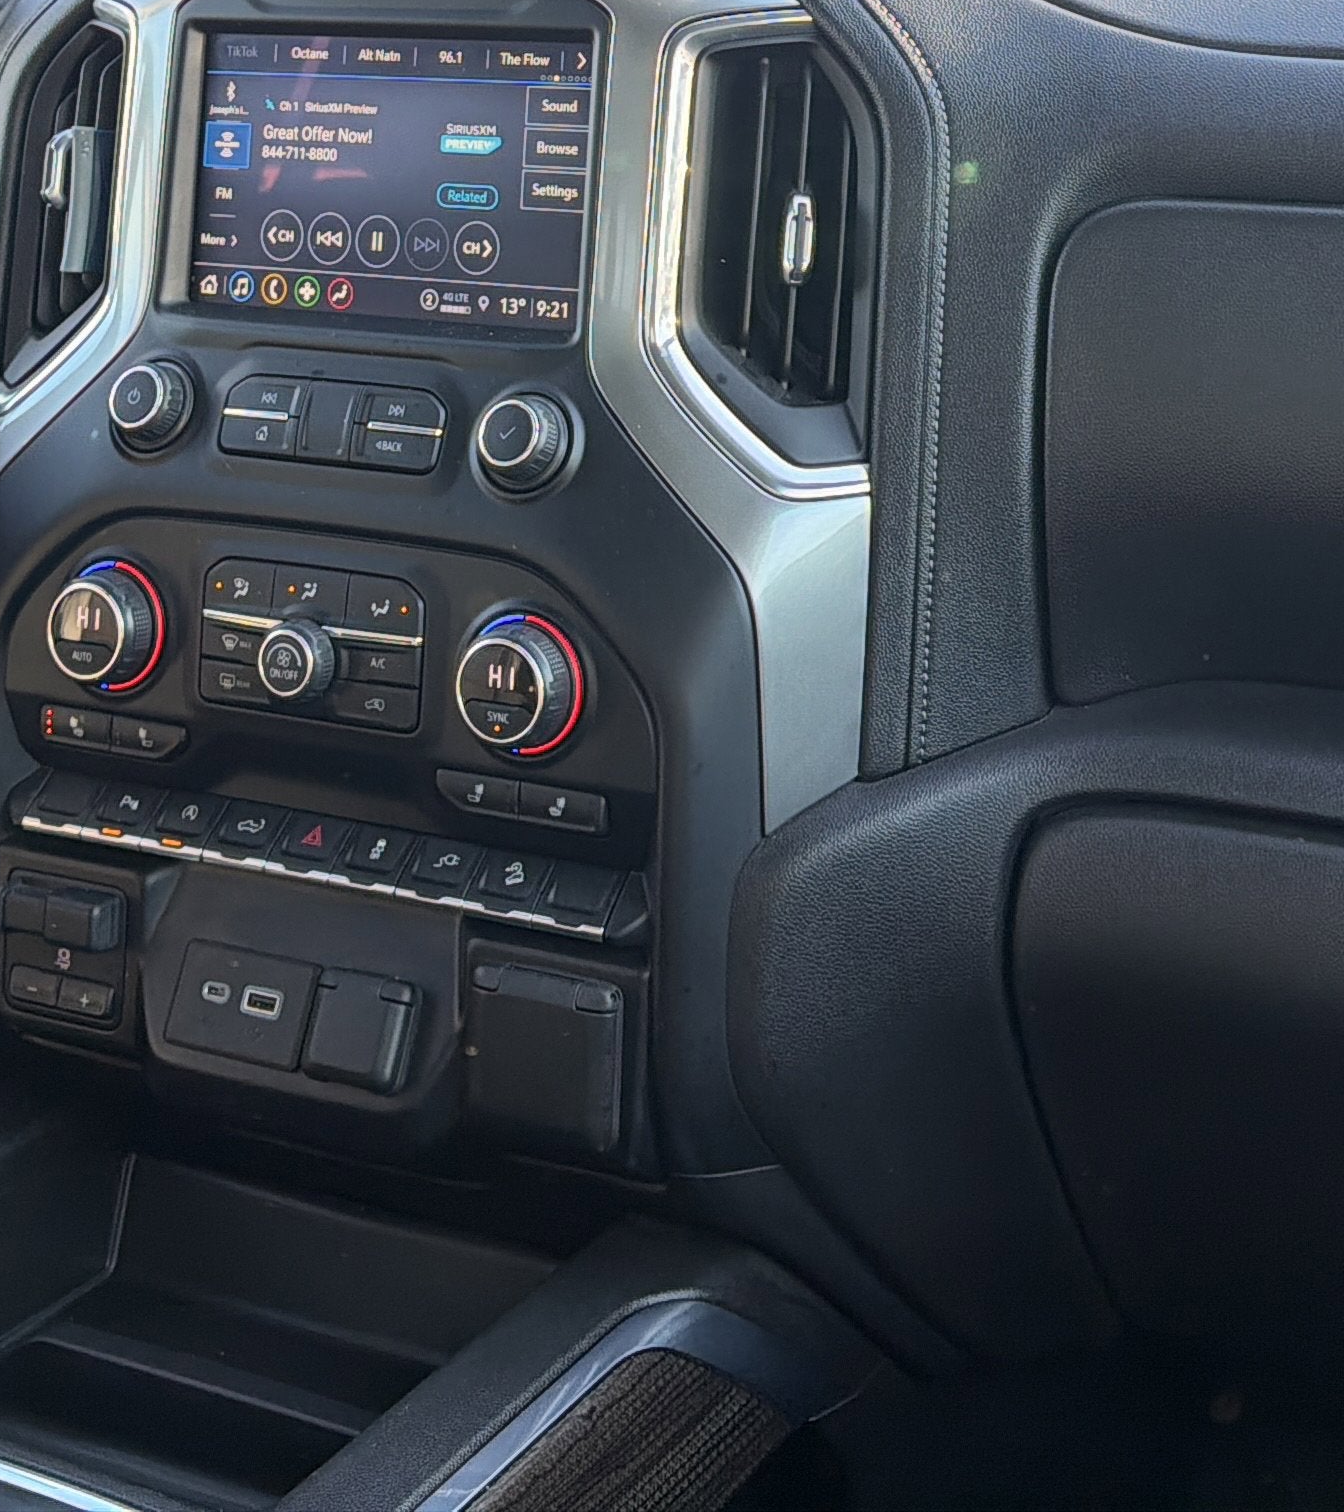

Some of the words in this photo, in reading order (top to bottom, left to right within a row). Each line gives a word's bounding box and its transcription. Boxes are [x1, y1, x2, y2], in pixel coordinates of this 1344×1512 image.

[227, 45, 259, 58] TikTok
[291, 46, 329, 60] Octane
[357, 48, 374, 61] Alt
[374, 49, 402, 62] Natn
[438, 50, 463, 64] 96.1
[499, 52, 522, 66] The
[523, 53, 550, 67] Flow
[279, 100, 292, 112] Ch
[293, 101, 299, 112] 1
[304, 101, 343, 114] SiriusXM
[343, 103, 378, 115] Preview
[541, 98, 578, 113] Sound
[263, 123, 300, 141] Great
[301, 125, 336, 142] Offer
[337, 127, 374, 144] Now!
[445, 139, 493, 151] PREVIEW
[536, 141, 579, 156] Browse
[261, 144, 339, 162] 844-711-8800
[215, 186, 233, 200] FM
[447, 189, 488, 204] Related
[531, 182, 579, 202] Settings
[200, 232, 226, 247] More
[277, 229, 295, 243] CH
[462, 241, 481, 255] CH
[454, 293, 469, 303] LTE
[499, 297, 527, 316] 13°
[536, 299, 569, 319] 9:21
[382, 439, 404, 453] BACK
[76, 604, 101, 631] HI
[71, 649, 93, 663] AUTO
[369, 656, 387, 670] A/C
[269, 668, 299, 682] ON/OFF
[488, 662, 516, 692] HI
[486, 709, 511, 725] SYNC
